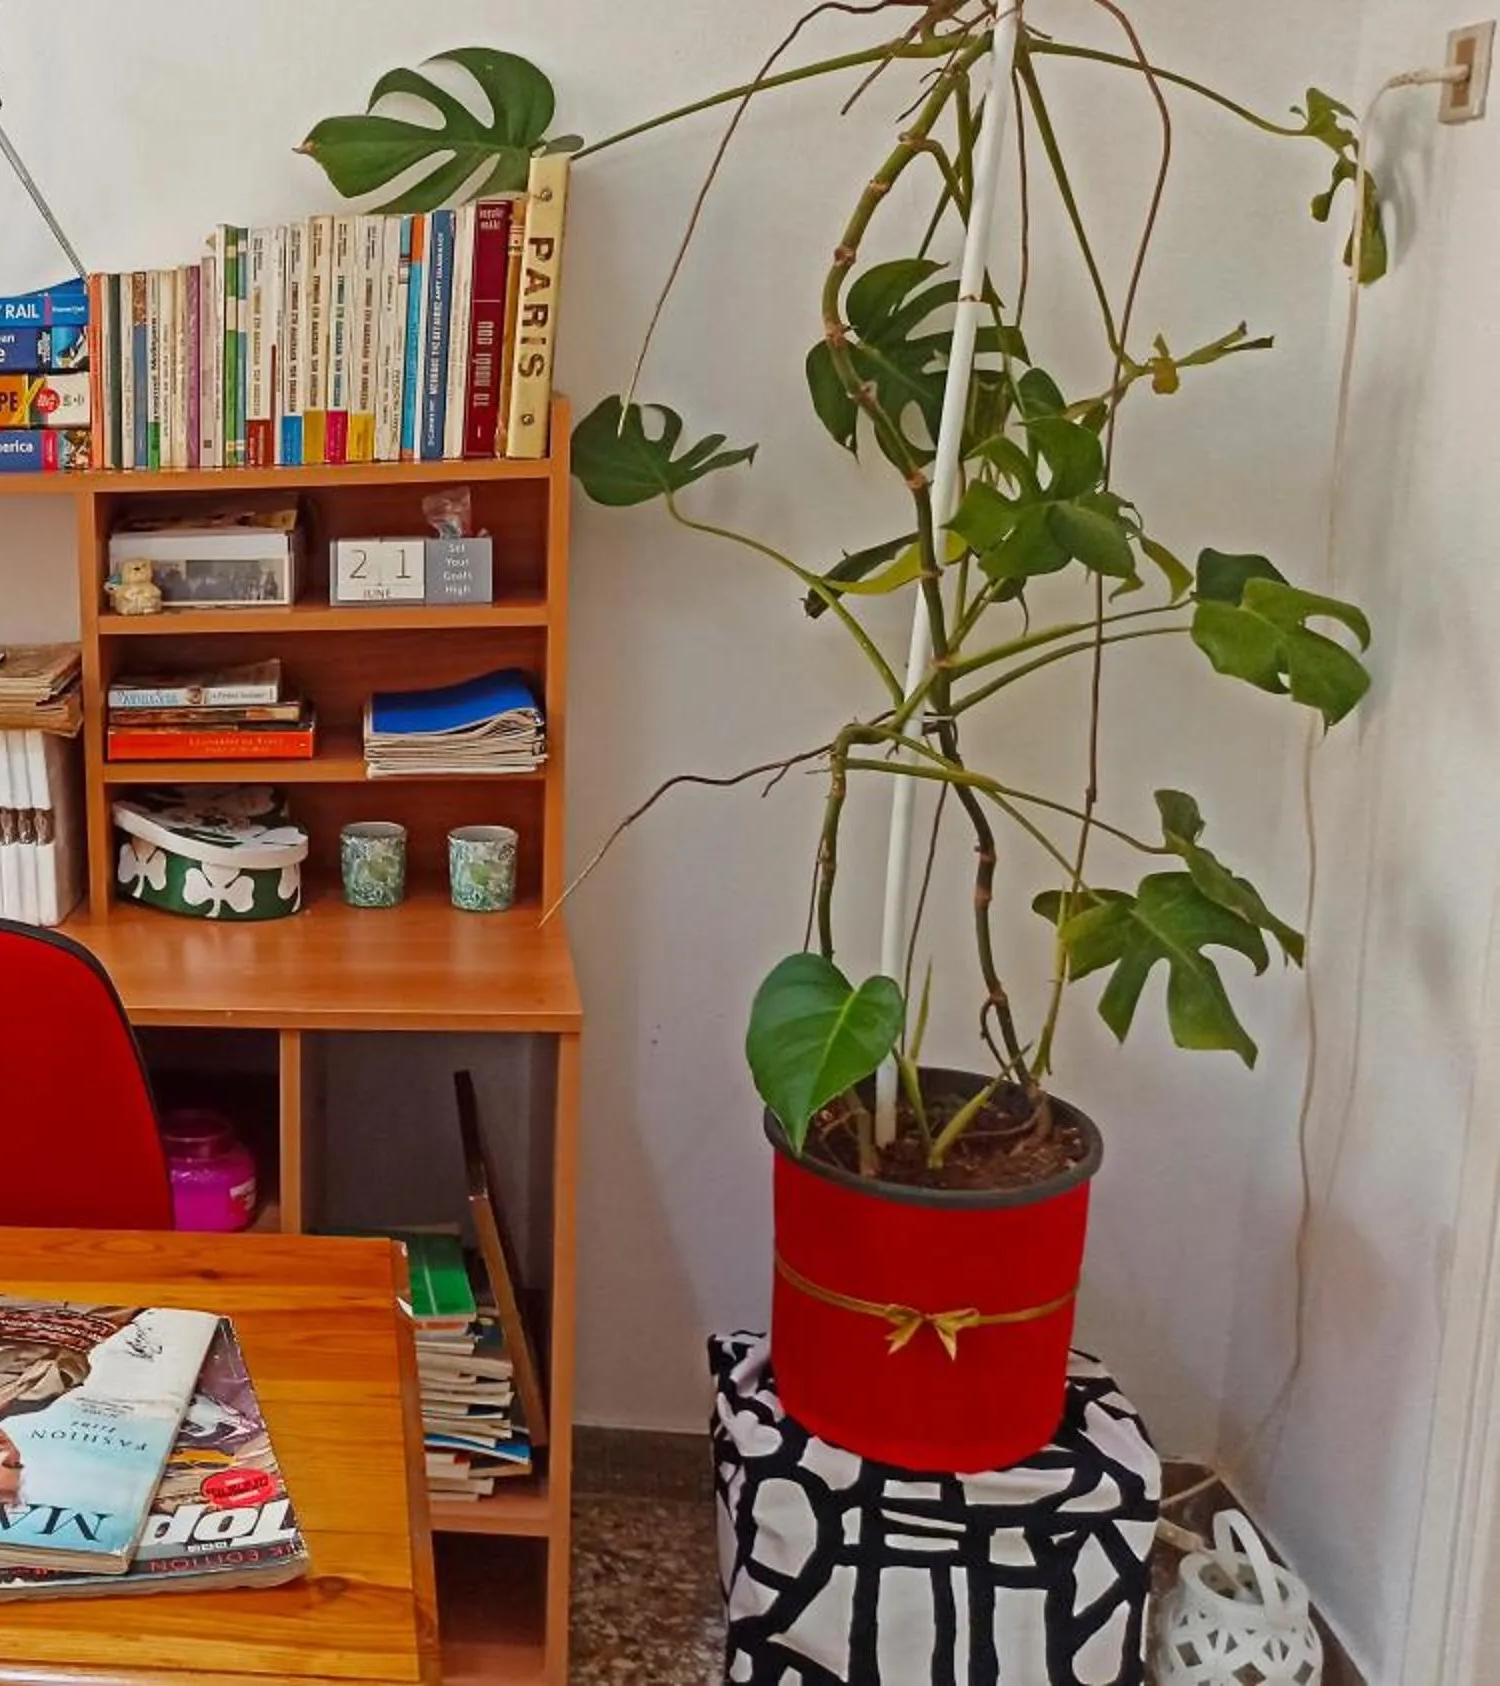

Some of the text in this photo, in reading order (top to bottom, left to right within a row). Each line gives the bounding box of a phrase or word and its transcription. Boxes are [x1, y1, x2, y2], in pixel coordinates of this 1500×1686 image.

[5, 302, 41, 319] RAIL
[518, 236, 555, 379] PARIS
[448, 543, 466, 553] Set
[446, 558, 470, 567] Your
[363, 588, 392, 599] JUNE
[31, 1428, 148, 1451] FASHION
